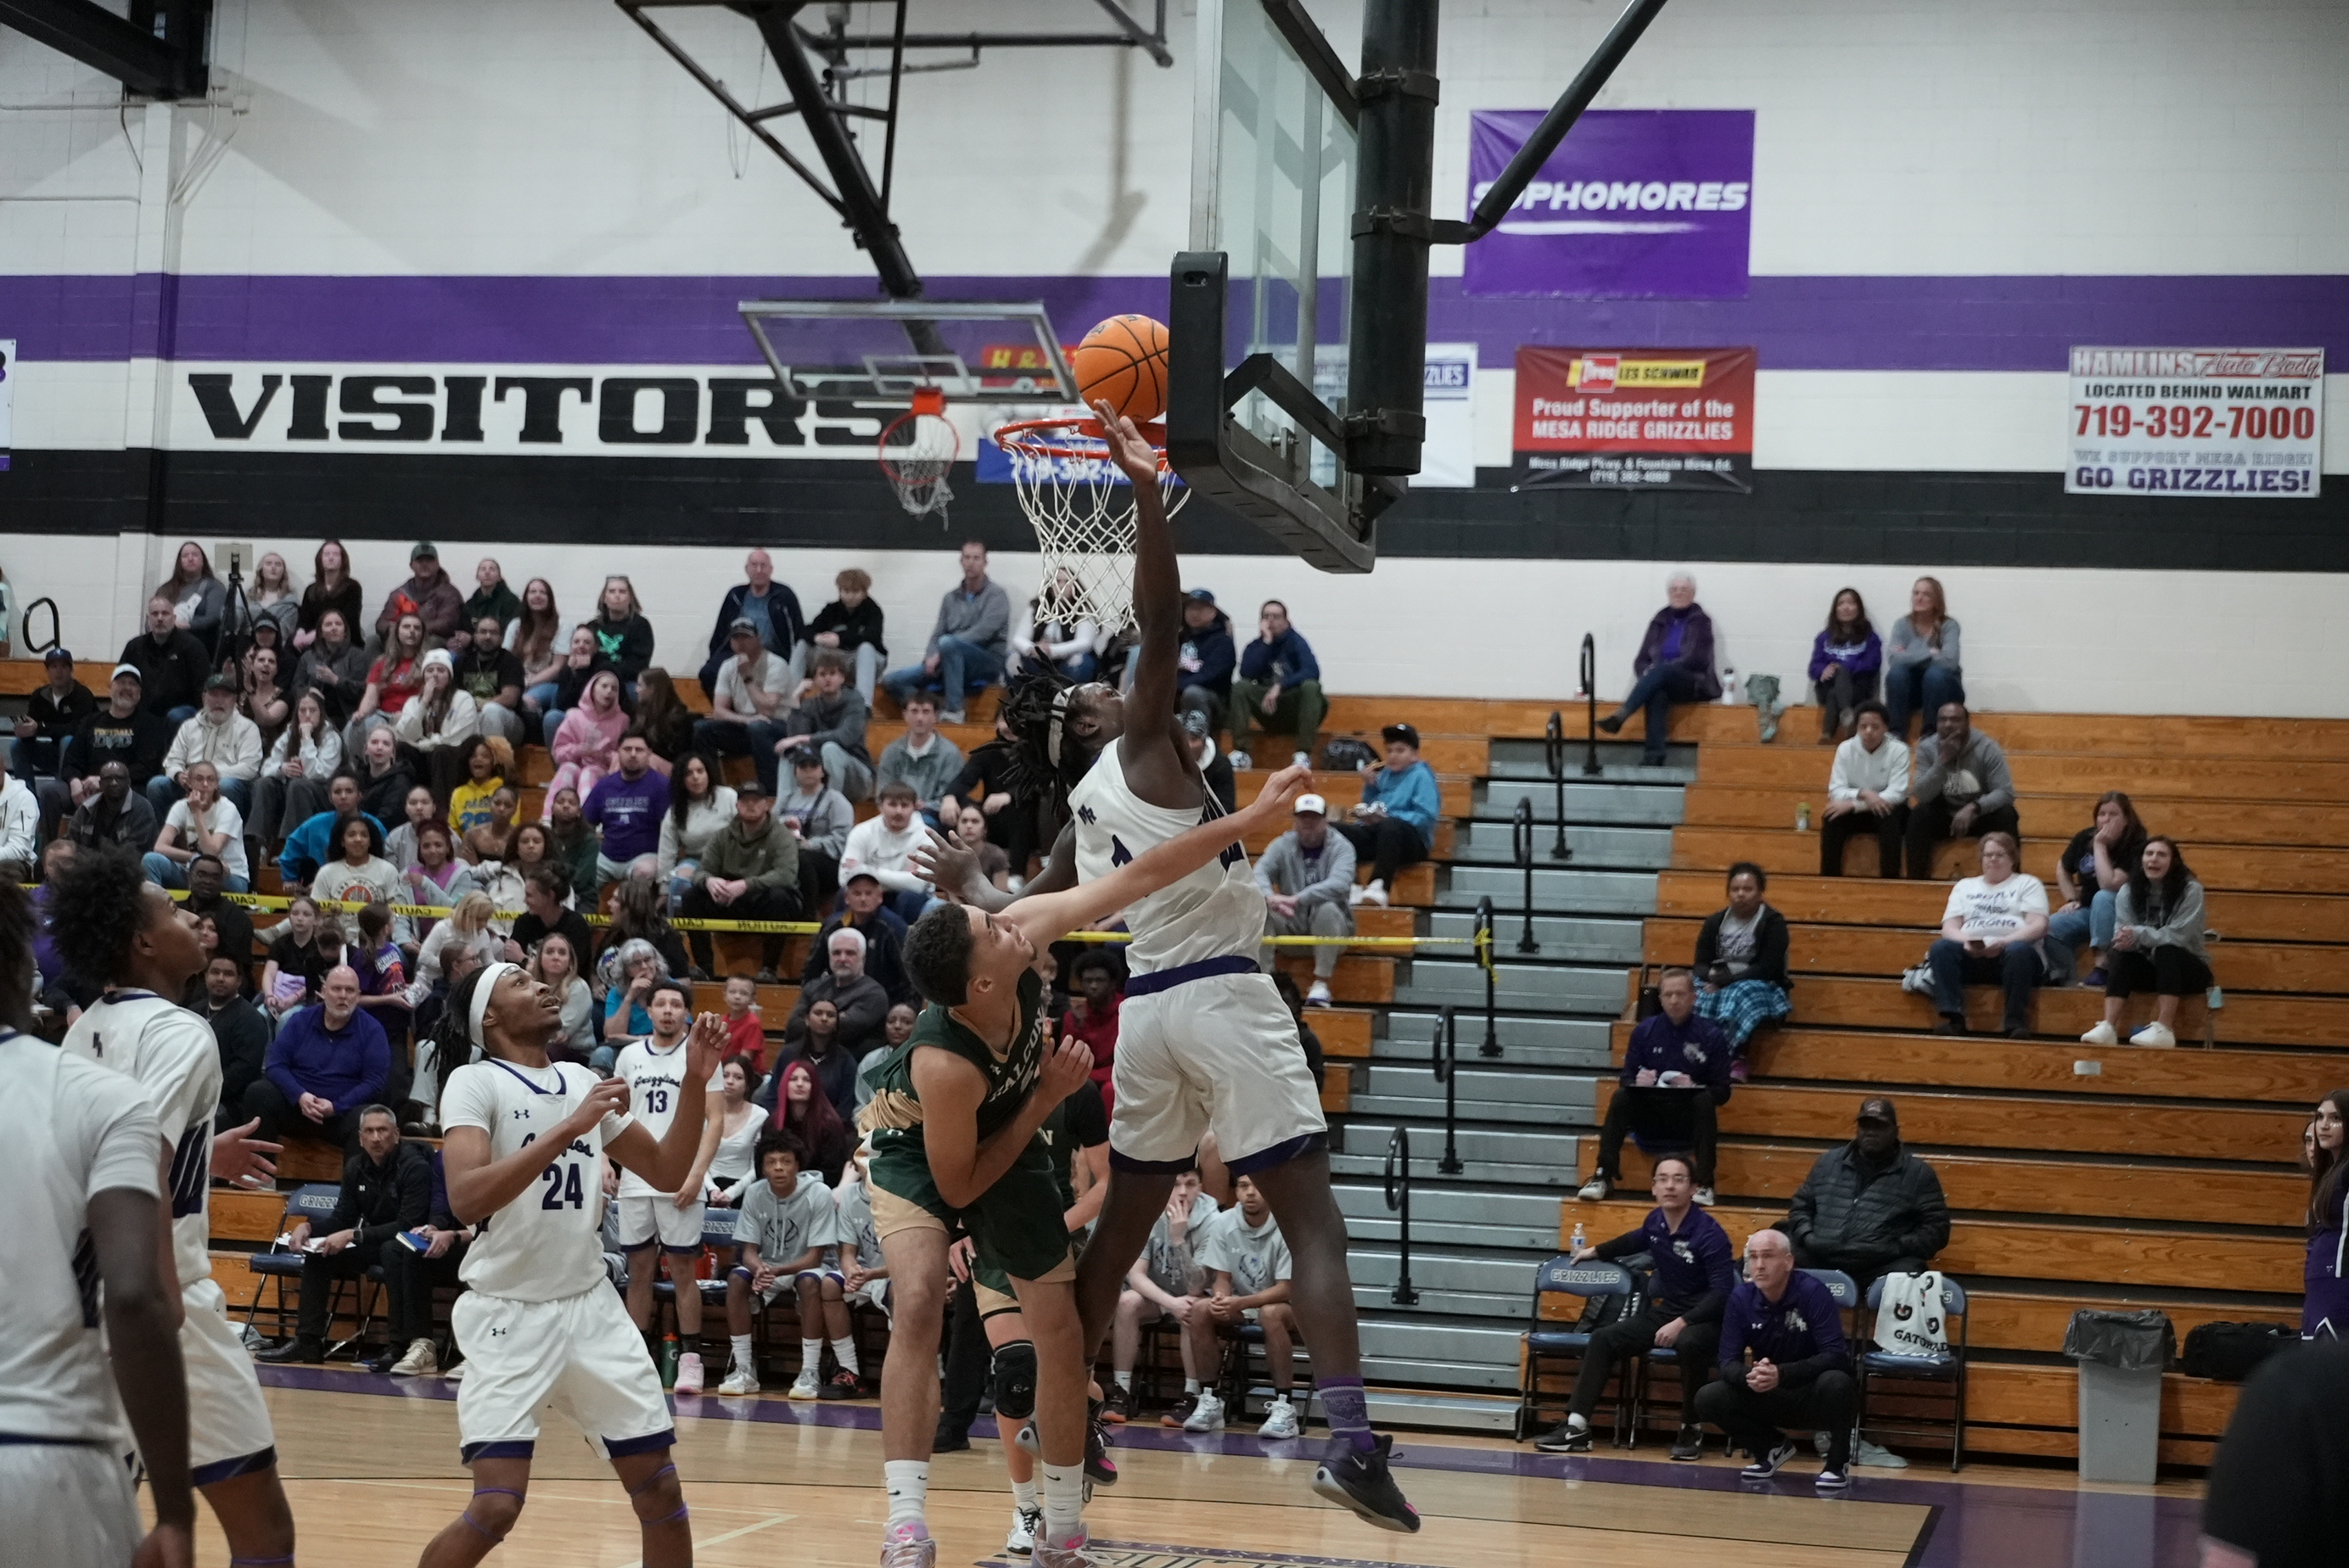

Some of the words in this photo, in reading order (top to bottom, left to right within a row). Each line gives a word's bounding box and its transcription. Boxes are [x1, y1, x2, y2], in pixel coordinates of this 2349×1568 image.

[1470, 181, 1749, 211] SPHOMORES
[2072, 350, 2196, 377] HAMLINS
[2085, 384, 2156, 399] LOCATED
[2161, 384, 2223, 400] BEHIND
[2228, 384, 2312, 400] WALMART
[188, 373, 917, 447] VISITORS
[1533, 399, 1584, 417] Proud
[1589, 399, 1677, 421] Supporter
[1681, 400, 1701, 417] of
[1704, 400, 1735, 418] the
[2074, 405, 2315, 440] 719-392-7000
[1533, 421, 1582, 440] MESA
[1587, 421, 1639, 440] RIDGE
[1644, 422, 1733, 440] GRIZZLIES
[2074, 451, 2101, 463] WE
[2108, 451, 2189, 464] SUPPORT
[2076, 466, 2114, 489] GO
[2128, 468, 2311, 492] GRIZZLIES!
[645, 1089, 668, 1114] 13
[541, 1162, 584, 1210] 24
[1550, 1268, 1621, 1285] GRIZZLIES
[1893, 1330, 1949, 1352] GATORAD
